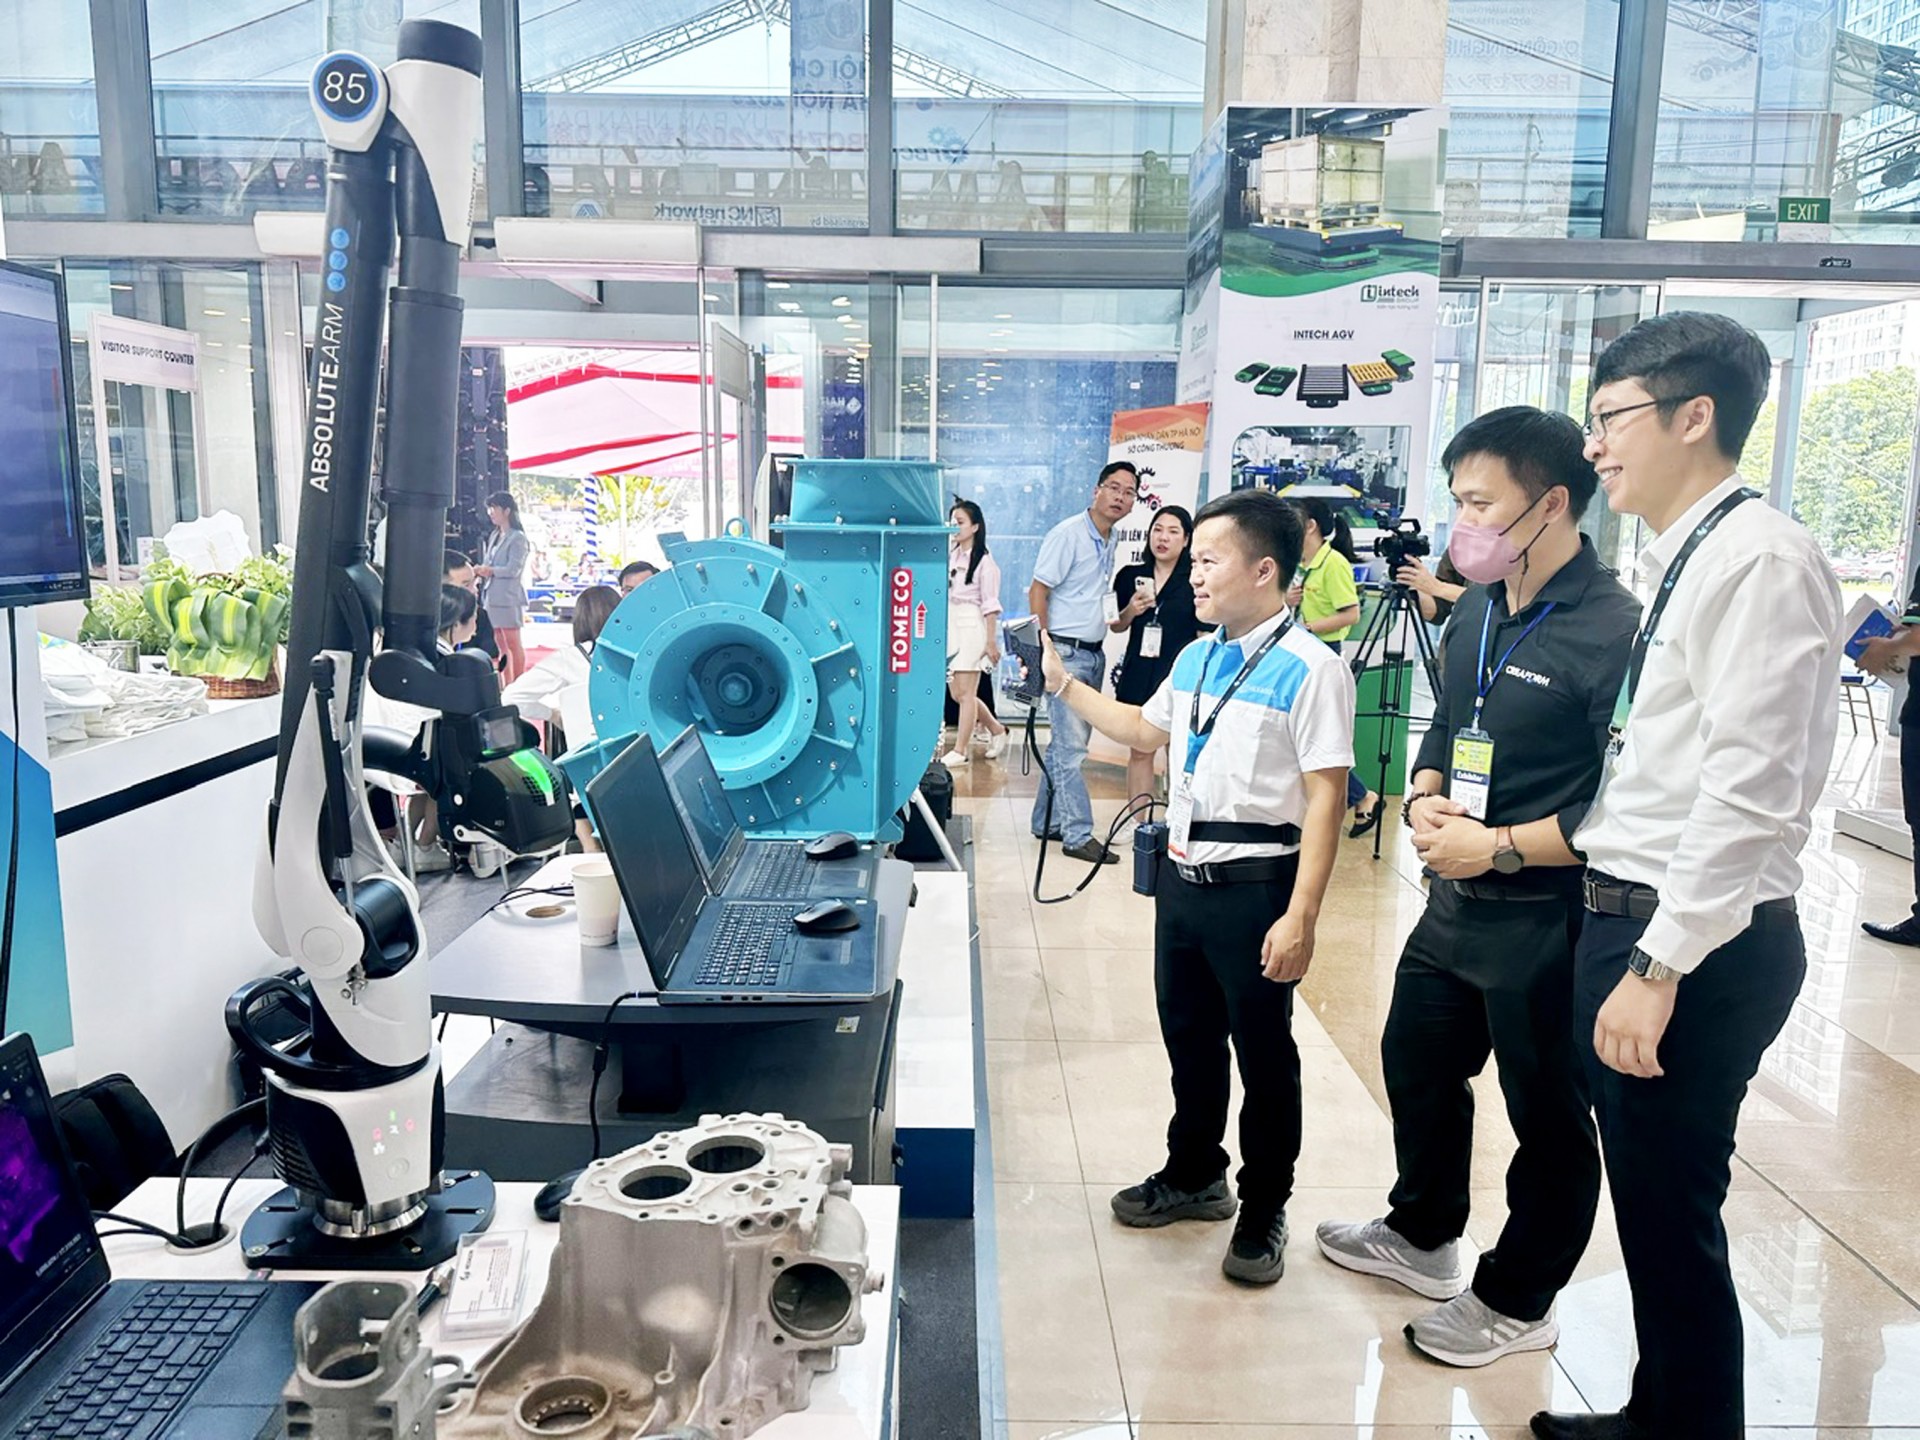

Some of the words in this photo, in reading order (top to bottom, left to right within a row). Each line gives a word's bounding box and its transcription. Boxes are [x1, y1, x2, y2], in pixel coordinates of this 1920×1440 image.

[324, 71, 368, 104] 85
[1787, 203, 1819, 222] EXIT
[1378, 284, 1420, 297] intech
[1293, 329, 1329, 340] INTECH
[1332, 329, 1355, 340] AGV
[101, 340, 131, 355] VISITOR
[132, 345, 163, 359] SUPPORT
[164, 350, 195, 365] COUNTER
[309, 302, 344, 493] ABSOLUTEARM
[891, 570, 910, 672] TOMECO
[1505, 665, 1552, 687] CREAFORM
[1456, 771, 1484, 782] Exhibitor
